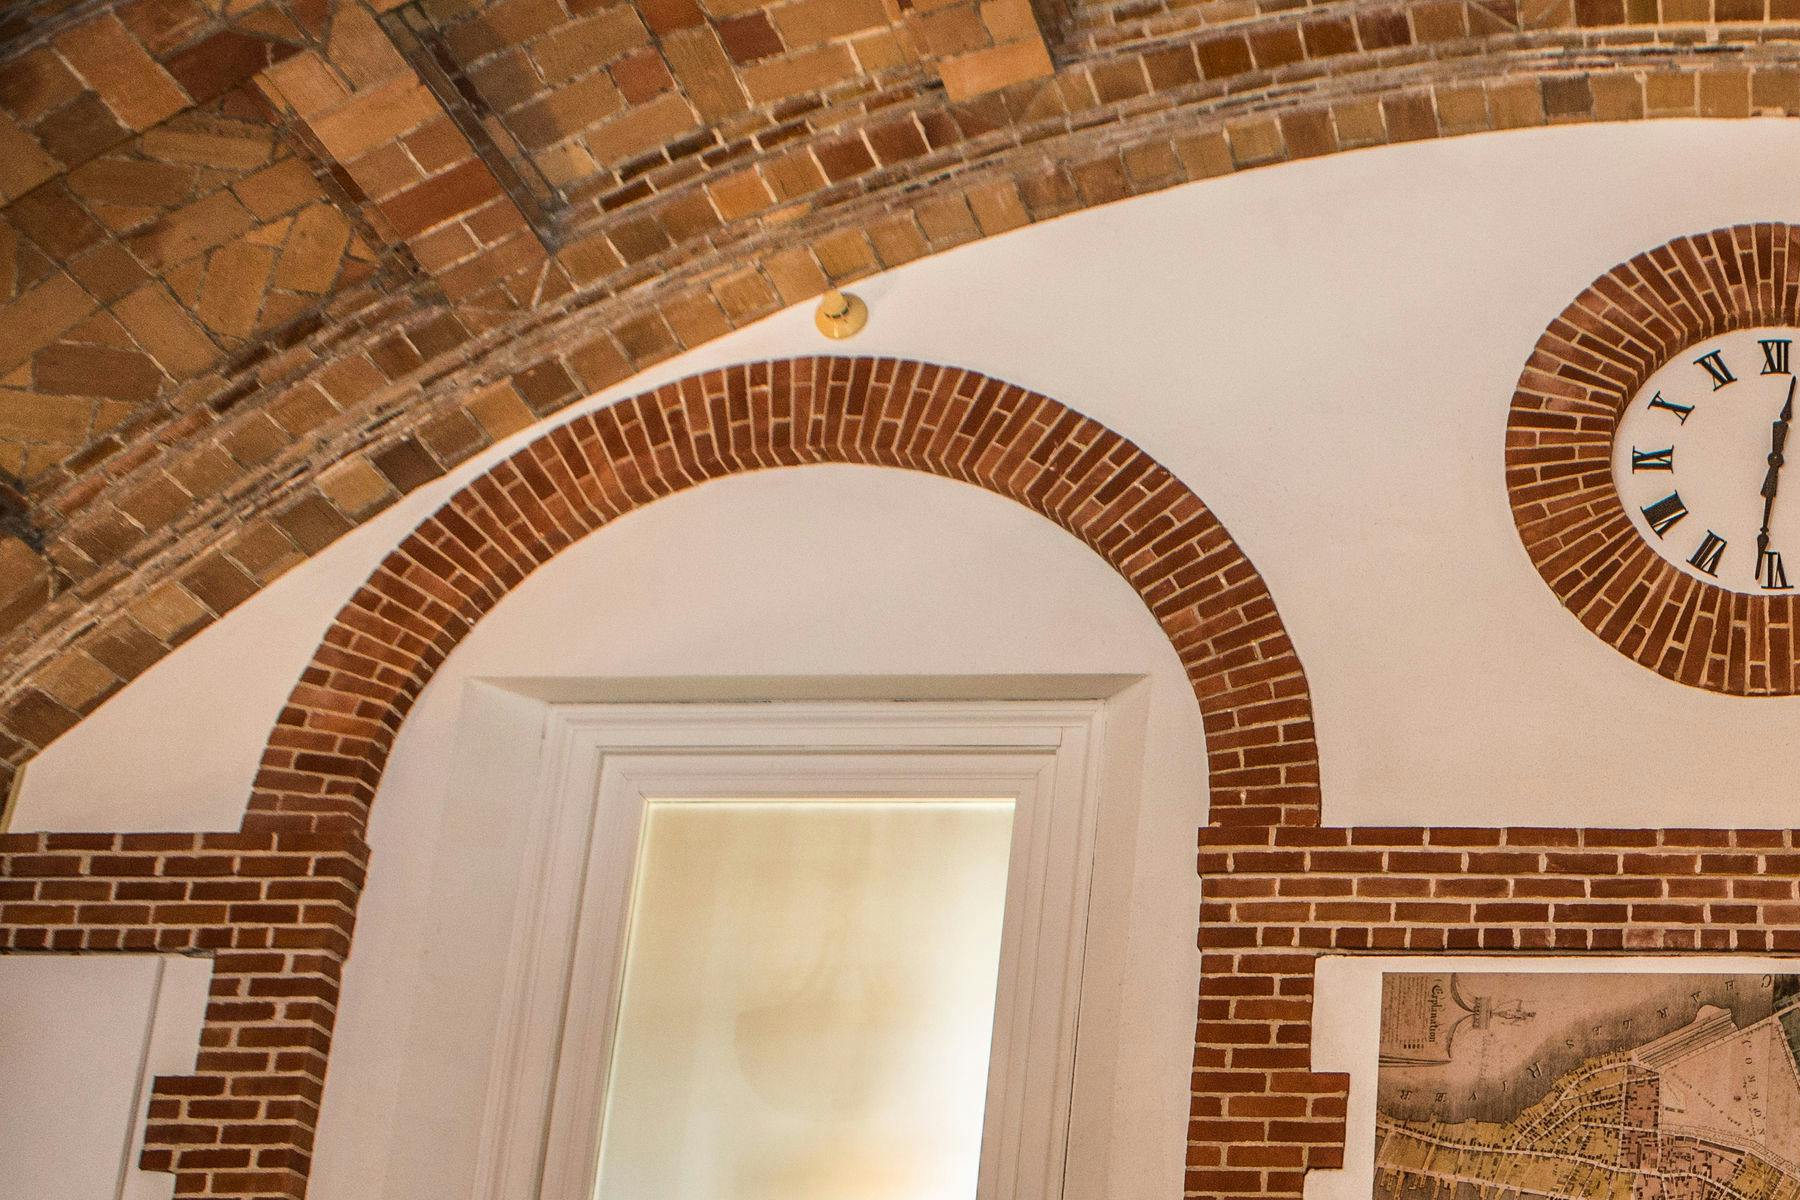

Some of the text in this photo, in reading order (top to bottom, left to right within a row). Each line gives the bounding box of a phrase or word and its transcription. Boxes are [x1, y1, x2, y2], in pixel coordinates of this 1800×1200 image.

[1693, 349, 1738, 391] XI
[1757, 339, 1793, 375] XII
[1647, 390, 1695, 426] X
[1632, 445, 1674, 475] IX
[1640, 490, 1689, 540] VIII
[1686, 529, 1728, 578] VII
[1760, 551, 1794, 590] VI
